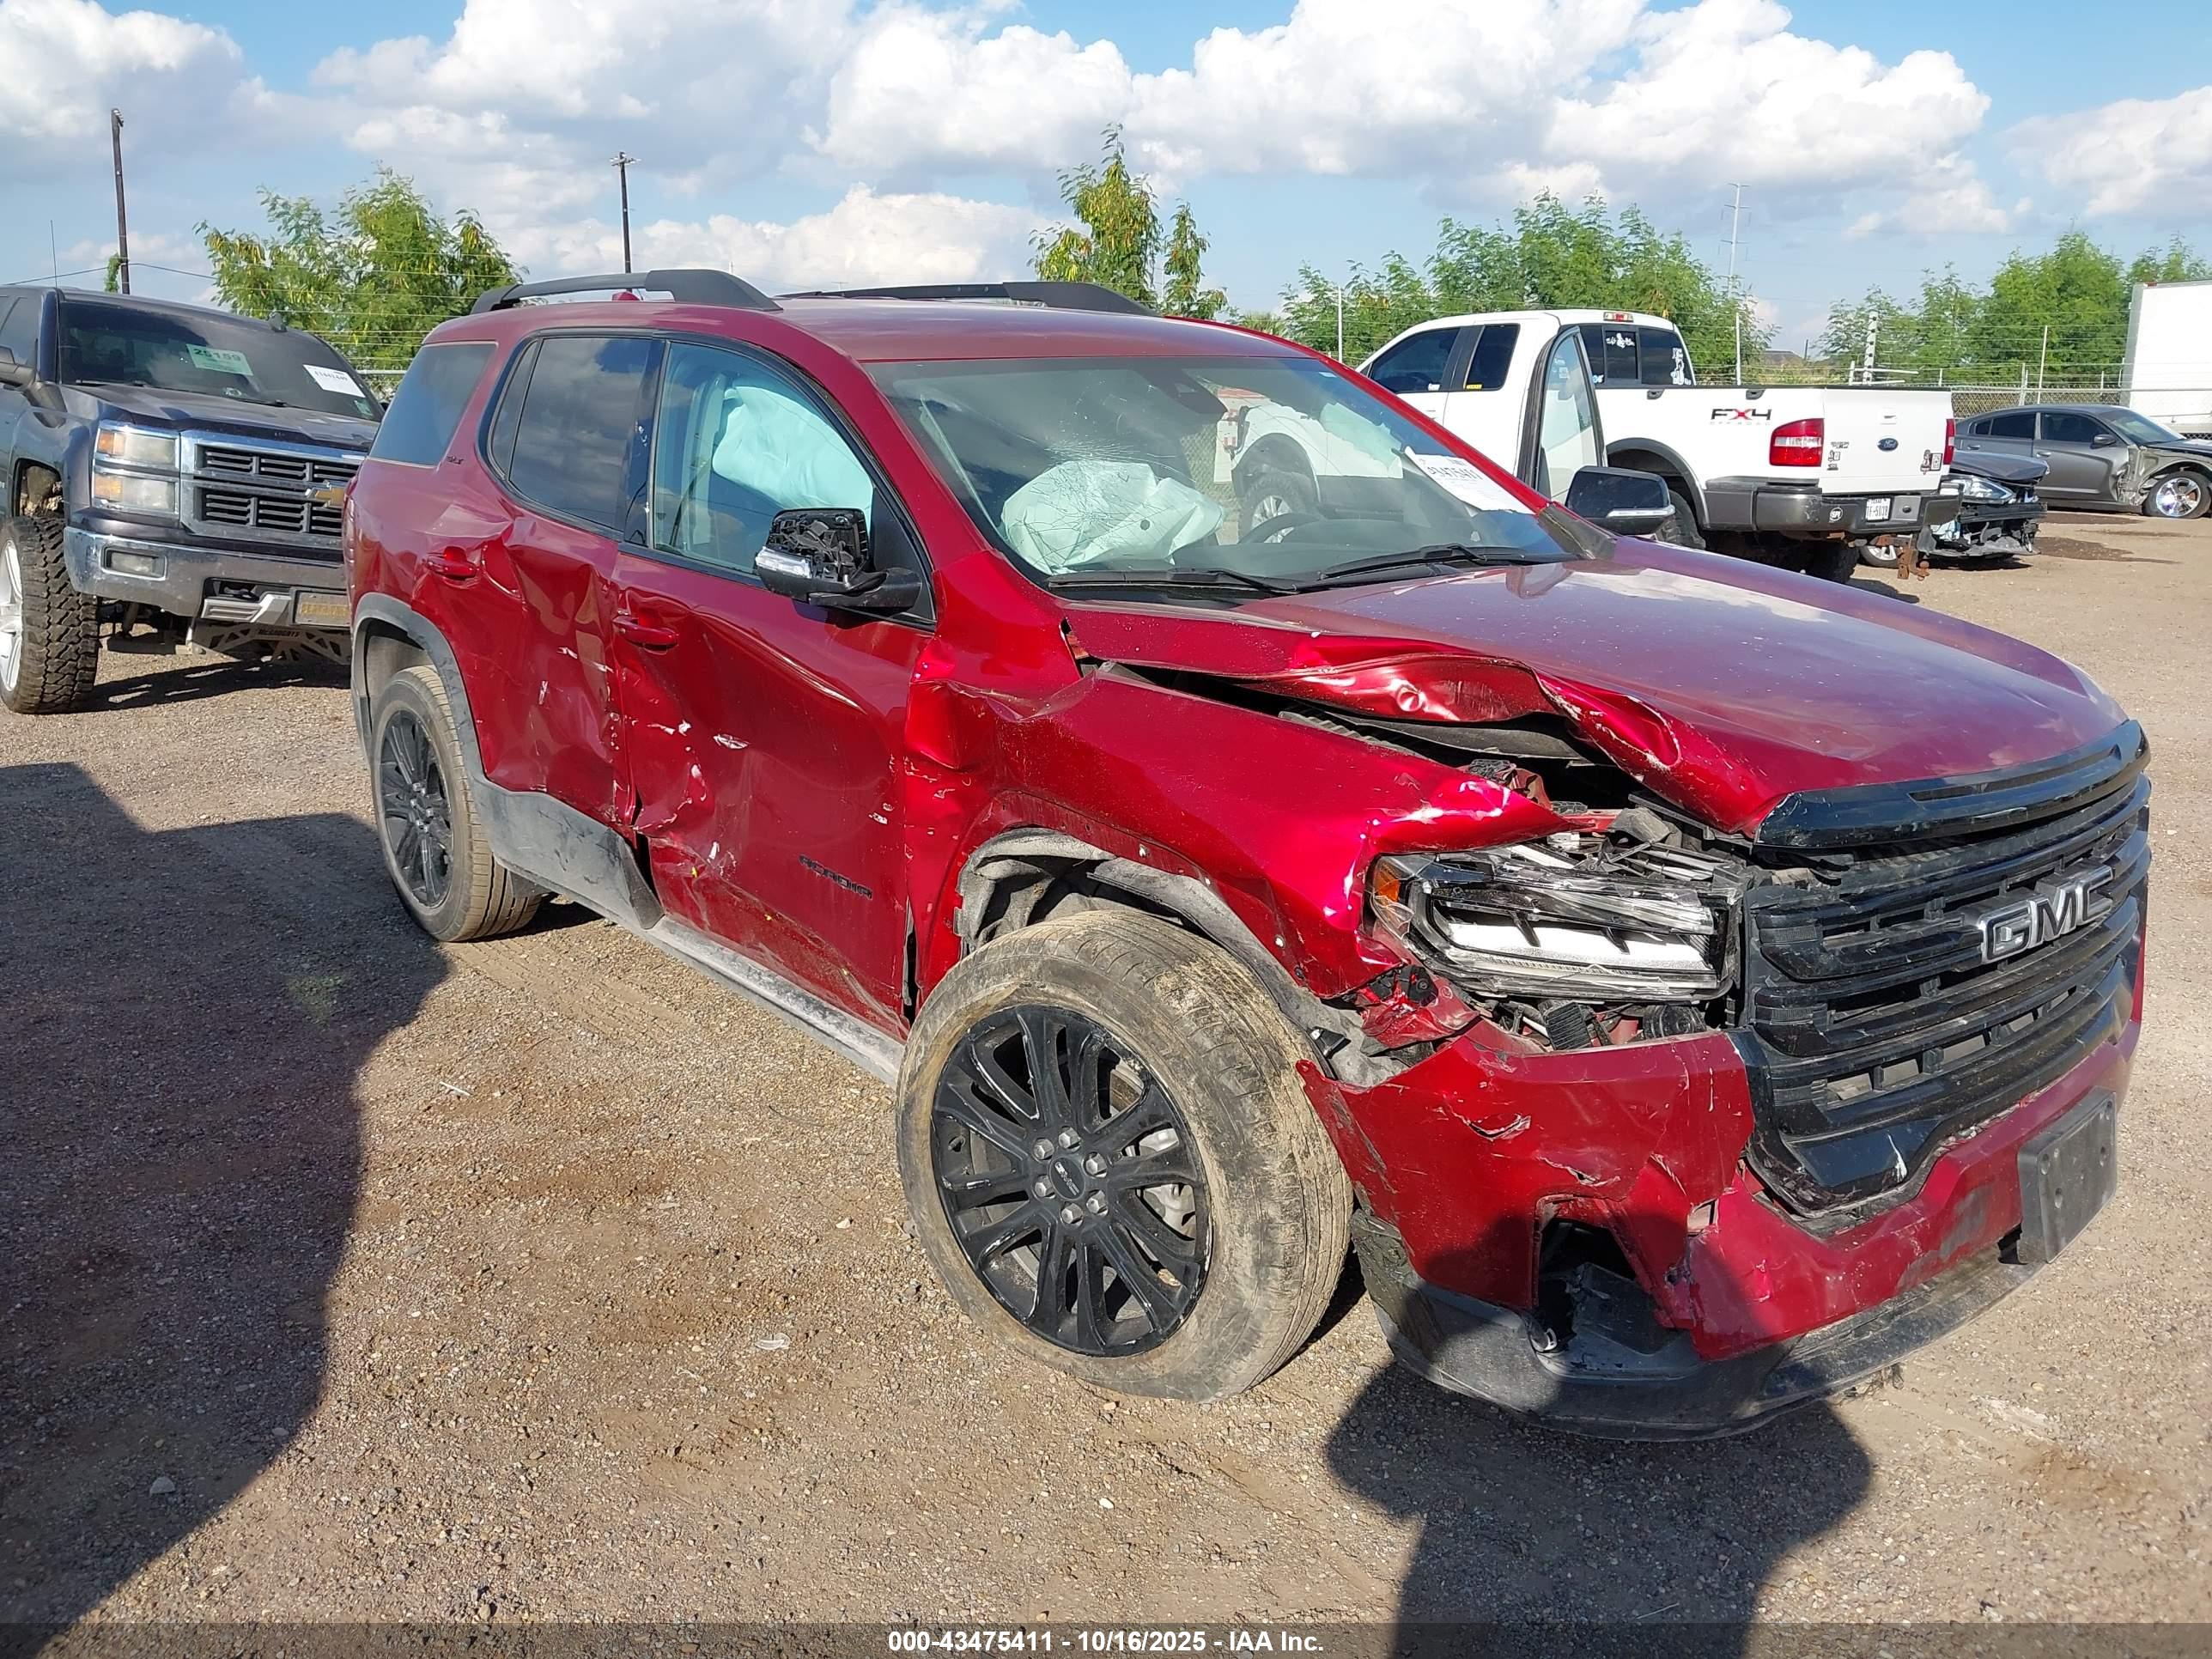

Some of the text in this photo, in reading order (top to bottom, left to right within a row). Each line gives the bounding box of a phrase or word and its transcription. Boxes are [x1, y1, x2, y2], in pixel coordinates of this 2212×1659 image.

[1711, 408, 1772, 421] FX4
[799, 855, 872, 899] ACADIA
[1978, 864, 2113, 965] GMC
